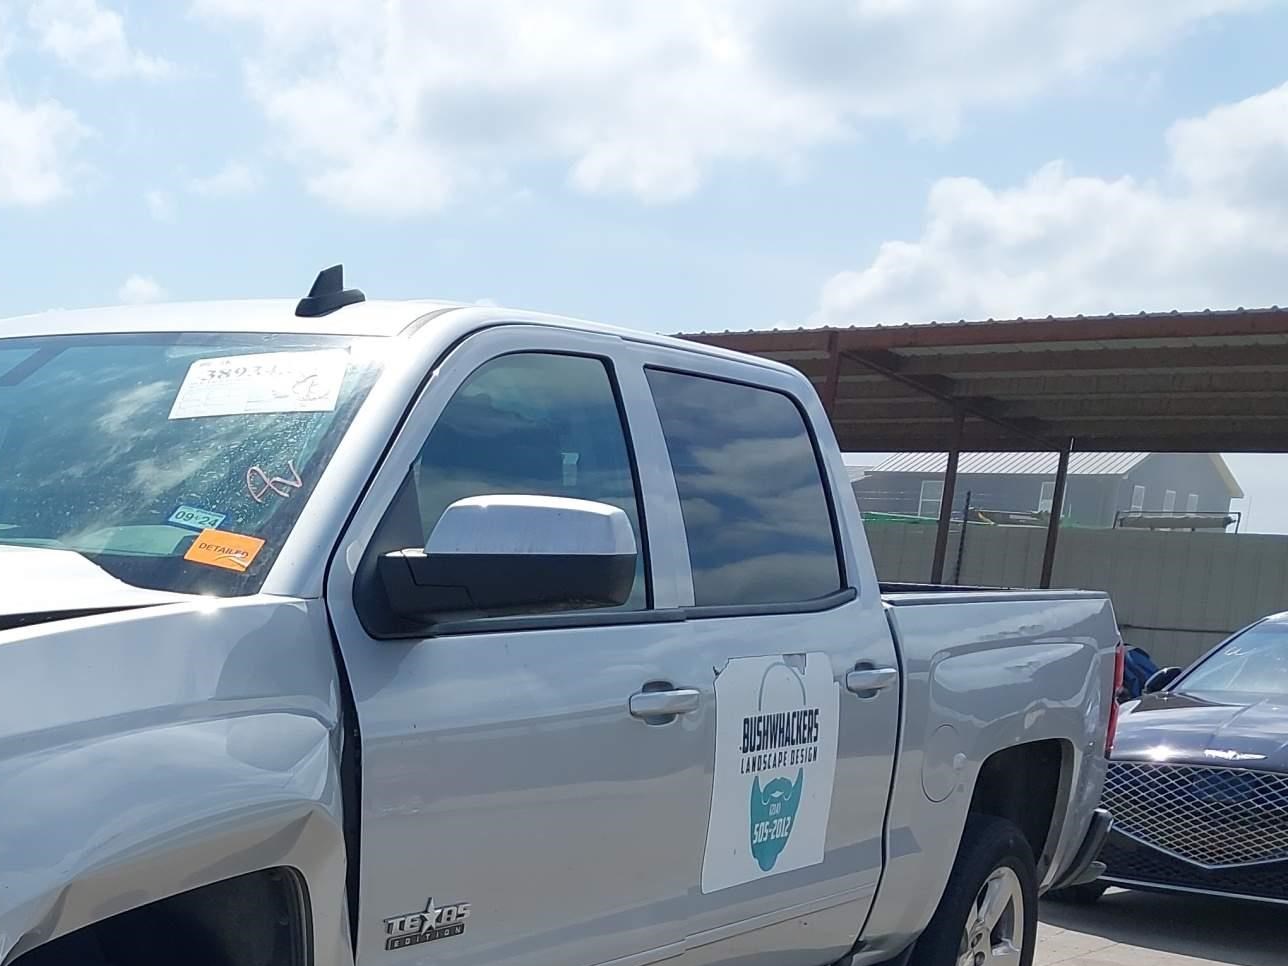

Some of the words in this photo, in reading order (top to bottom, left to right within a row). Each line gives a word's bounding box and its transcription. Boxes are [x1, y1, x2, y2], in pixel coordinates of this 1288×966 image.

[174, 510, 194, 522] 09
[198, 516, 219, 527] 24
[742, 708, 819, 754] BUSHWHACKERS
[740, 751, 787, 774] LANDSCAPE
[790, 746, 818, 766] DESIGN
[384, 897, 471, 935] TEXAS
[393, 926, 462, 948] EDITION
